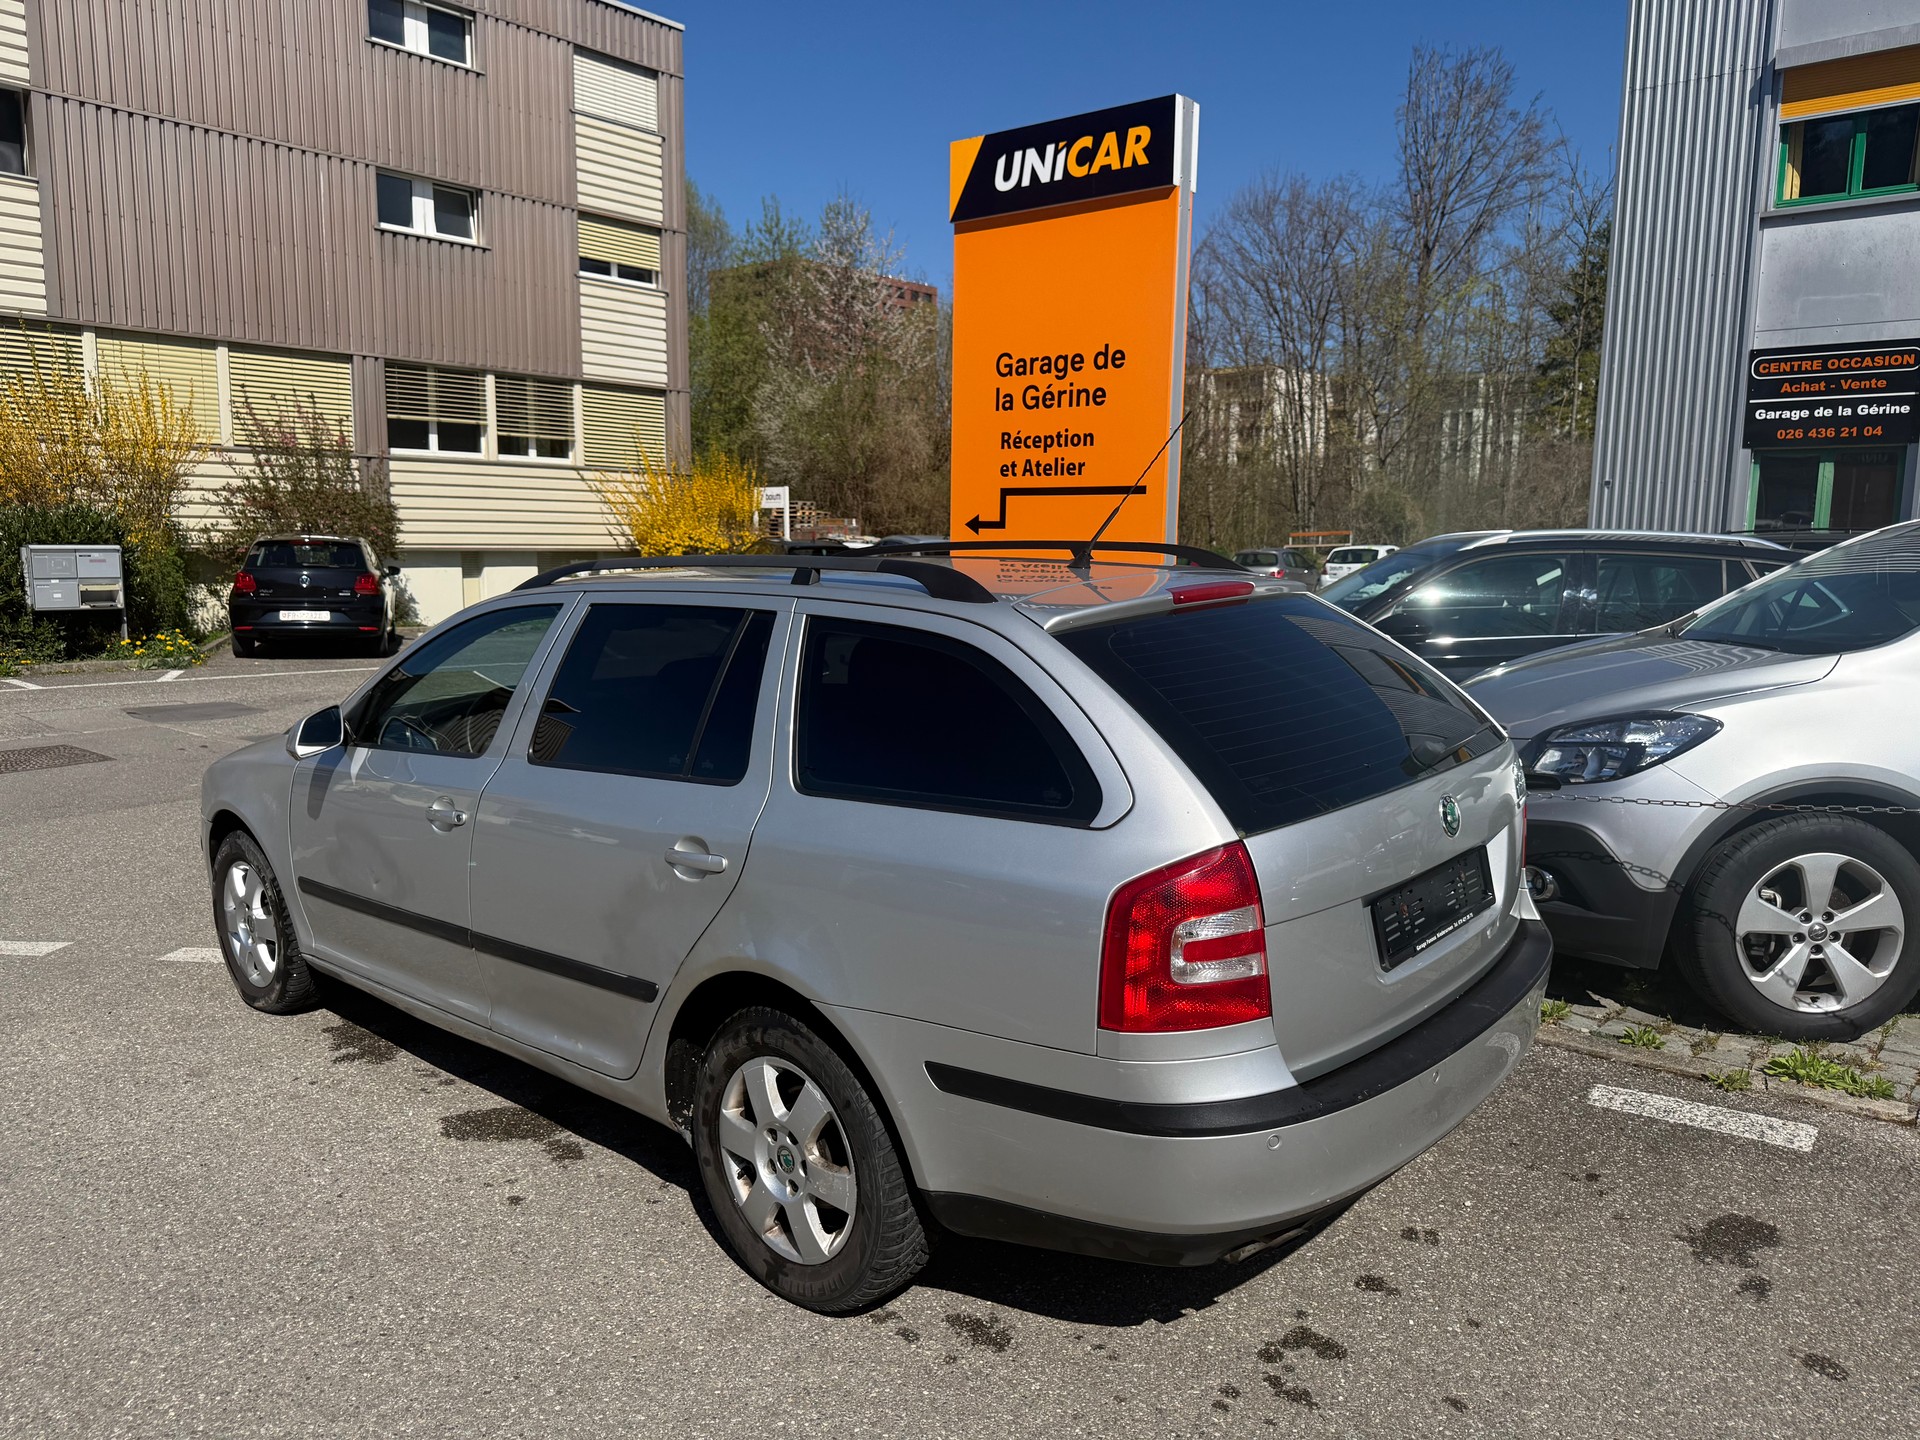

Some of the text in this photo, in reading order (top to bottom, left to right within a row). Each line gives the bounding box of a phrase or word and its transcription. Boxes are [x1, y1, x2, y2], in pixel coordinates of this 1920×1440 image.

[995, 343, 1126, 381] Garage de
[1758, 354, 1916, 374] CENTRE OCCASION
[1780, 381, 1826, 393] Achat
[1840, 378, 1888, 390] Vente
[995, 382, 1107, 412] la Gérine
[1755, 403, 1911, 421] Garage de la Gérine
[1000, 427, 1095, 454] Réception
[1776, 425, 1883, 440] 026 436 21 04
[1000, 456, 1086, 478] et Atelier
